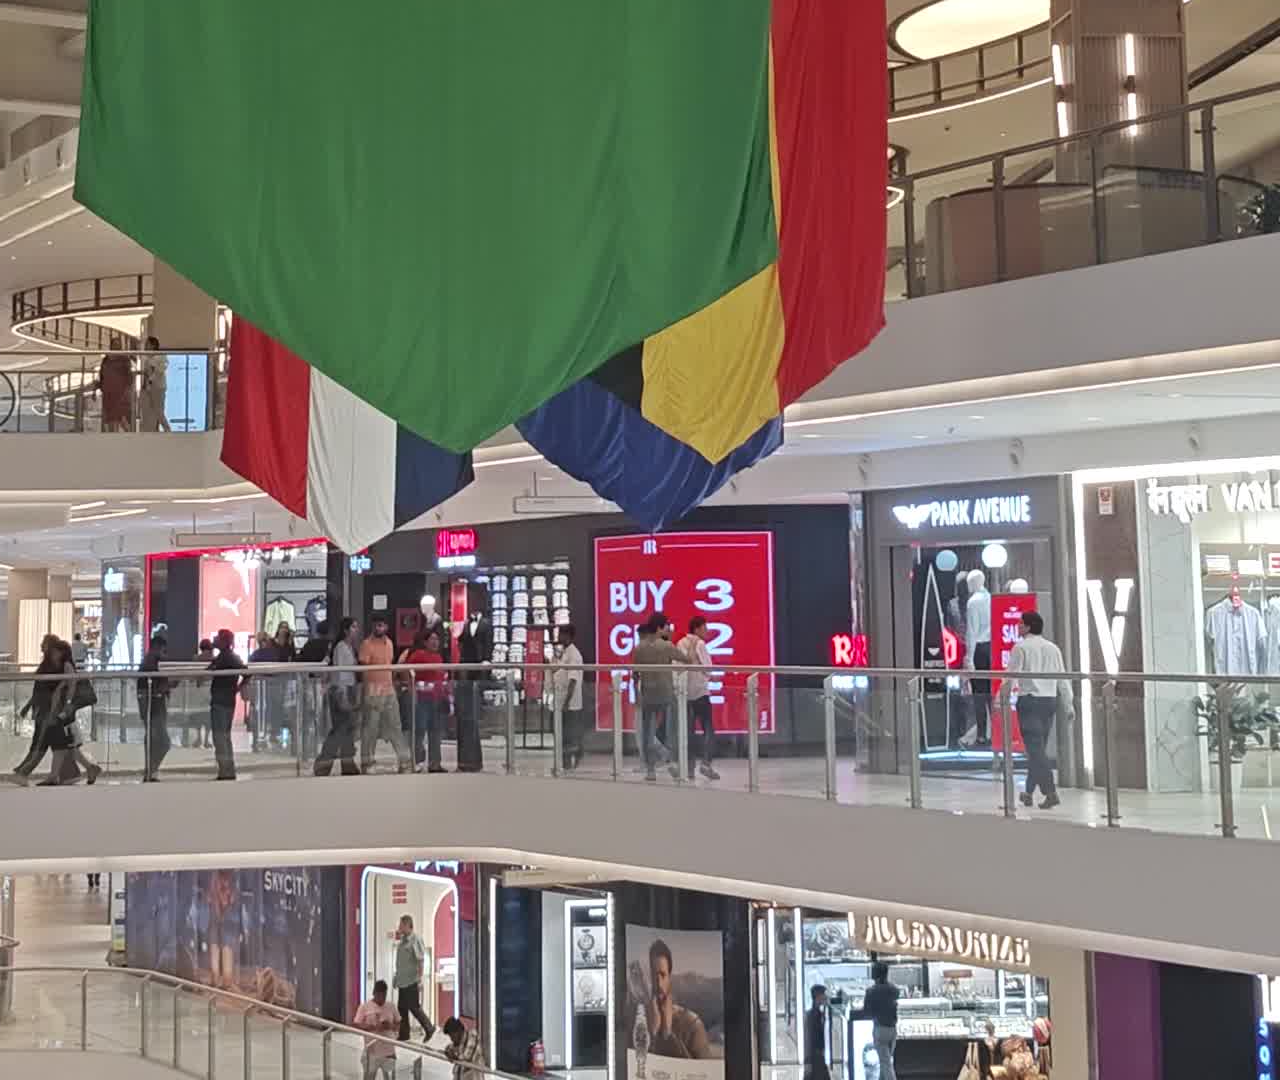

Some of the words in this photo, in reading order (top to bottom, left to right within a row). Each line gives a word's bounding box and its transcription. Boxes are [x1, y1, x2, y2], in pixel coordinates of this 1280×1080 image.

[930, 499, 969, 526] PARK
[973, 495, 1031, 524] AVENUE
[1221, 480, 1271, 512] VAN
[609, 580, 674, 613] BUY
[693, 578, 735, 611] 3
[705, 622, 734, 655] 2
